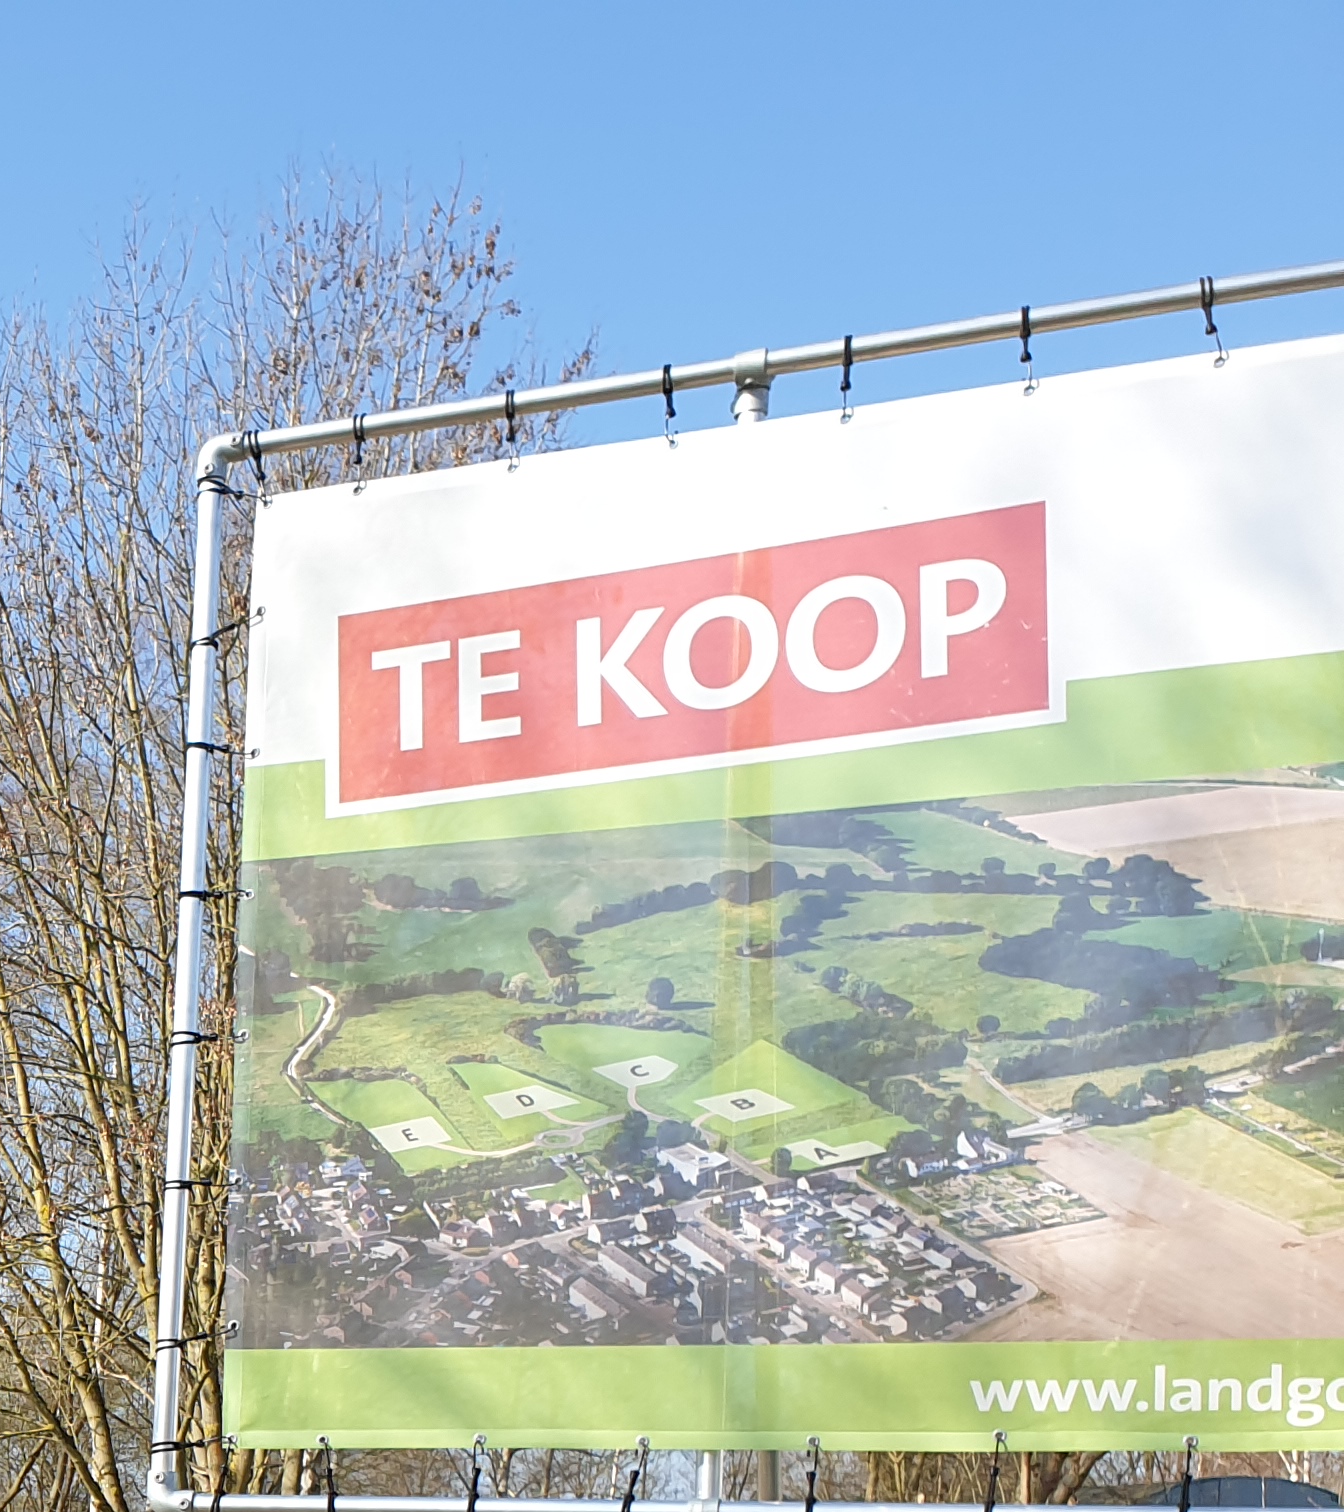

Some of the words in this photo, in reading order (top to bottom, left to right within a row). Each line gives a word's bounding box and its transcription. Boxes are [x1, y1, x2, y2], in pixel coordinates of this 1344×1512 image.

[371, 629, 522, 751] TE
[575, 558, 1007, 727] KOOP
[630, 1064, 650, 1078] C
[515, 1094, 535, 1108] D
[730, 1098, 756, 1110] B
[401, 1128, 419, 1142] E
[814, 1147, 839, 1160] A
